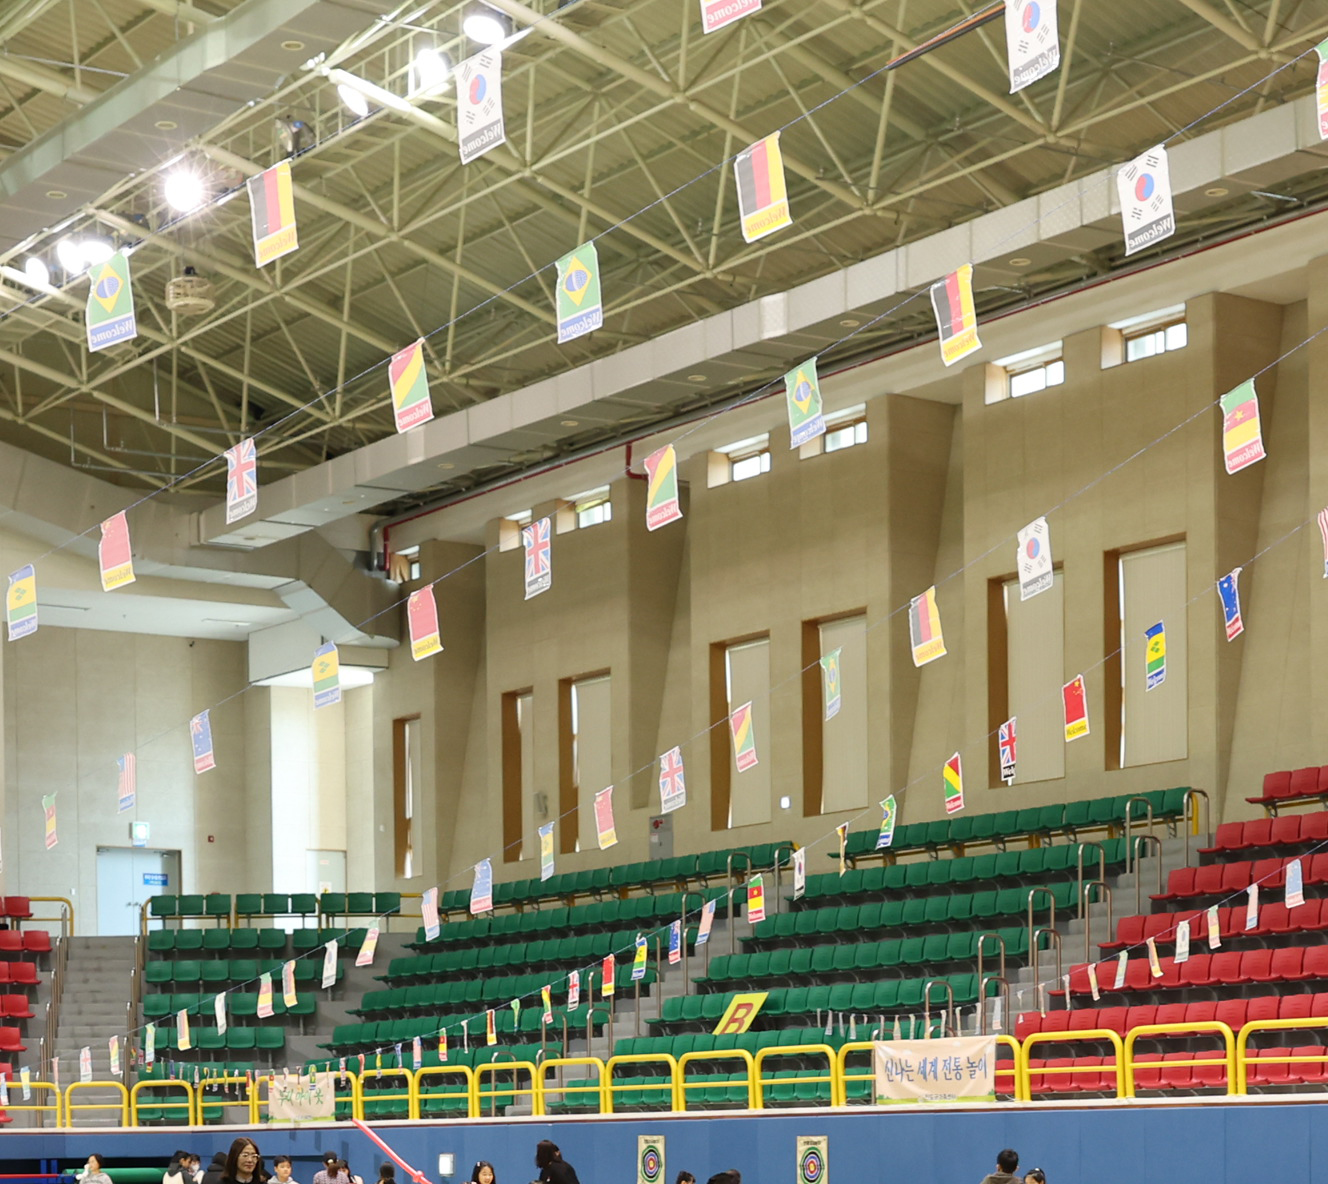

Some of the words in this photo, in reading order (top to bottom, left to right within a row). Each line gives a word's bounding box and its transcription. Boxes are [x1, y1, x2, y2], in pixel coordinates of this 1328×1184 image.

[885, 1058, 914, 1083] 신나는
[917, 1056, 939, 1082] 세계
[942, 1055, 964, 1081] 전통
[966, 1053, 988, 1080] 놀이
